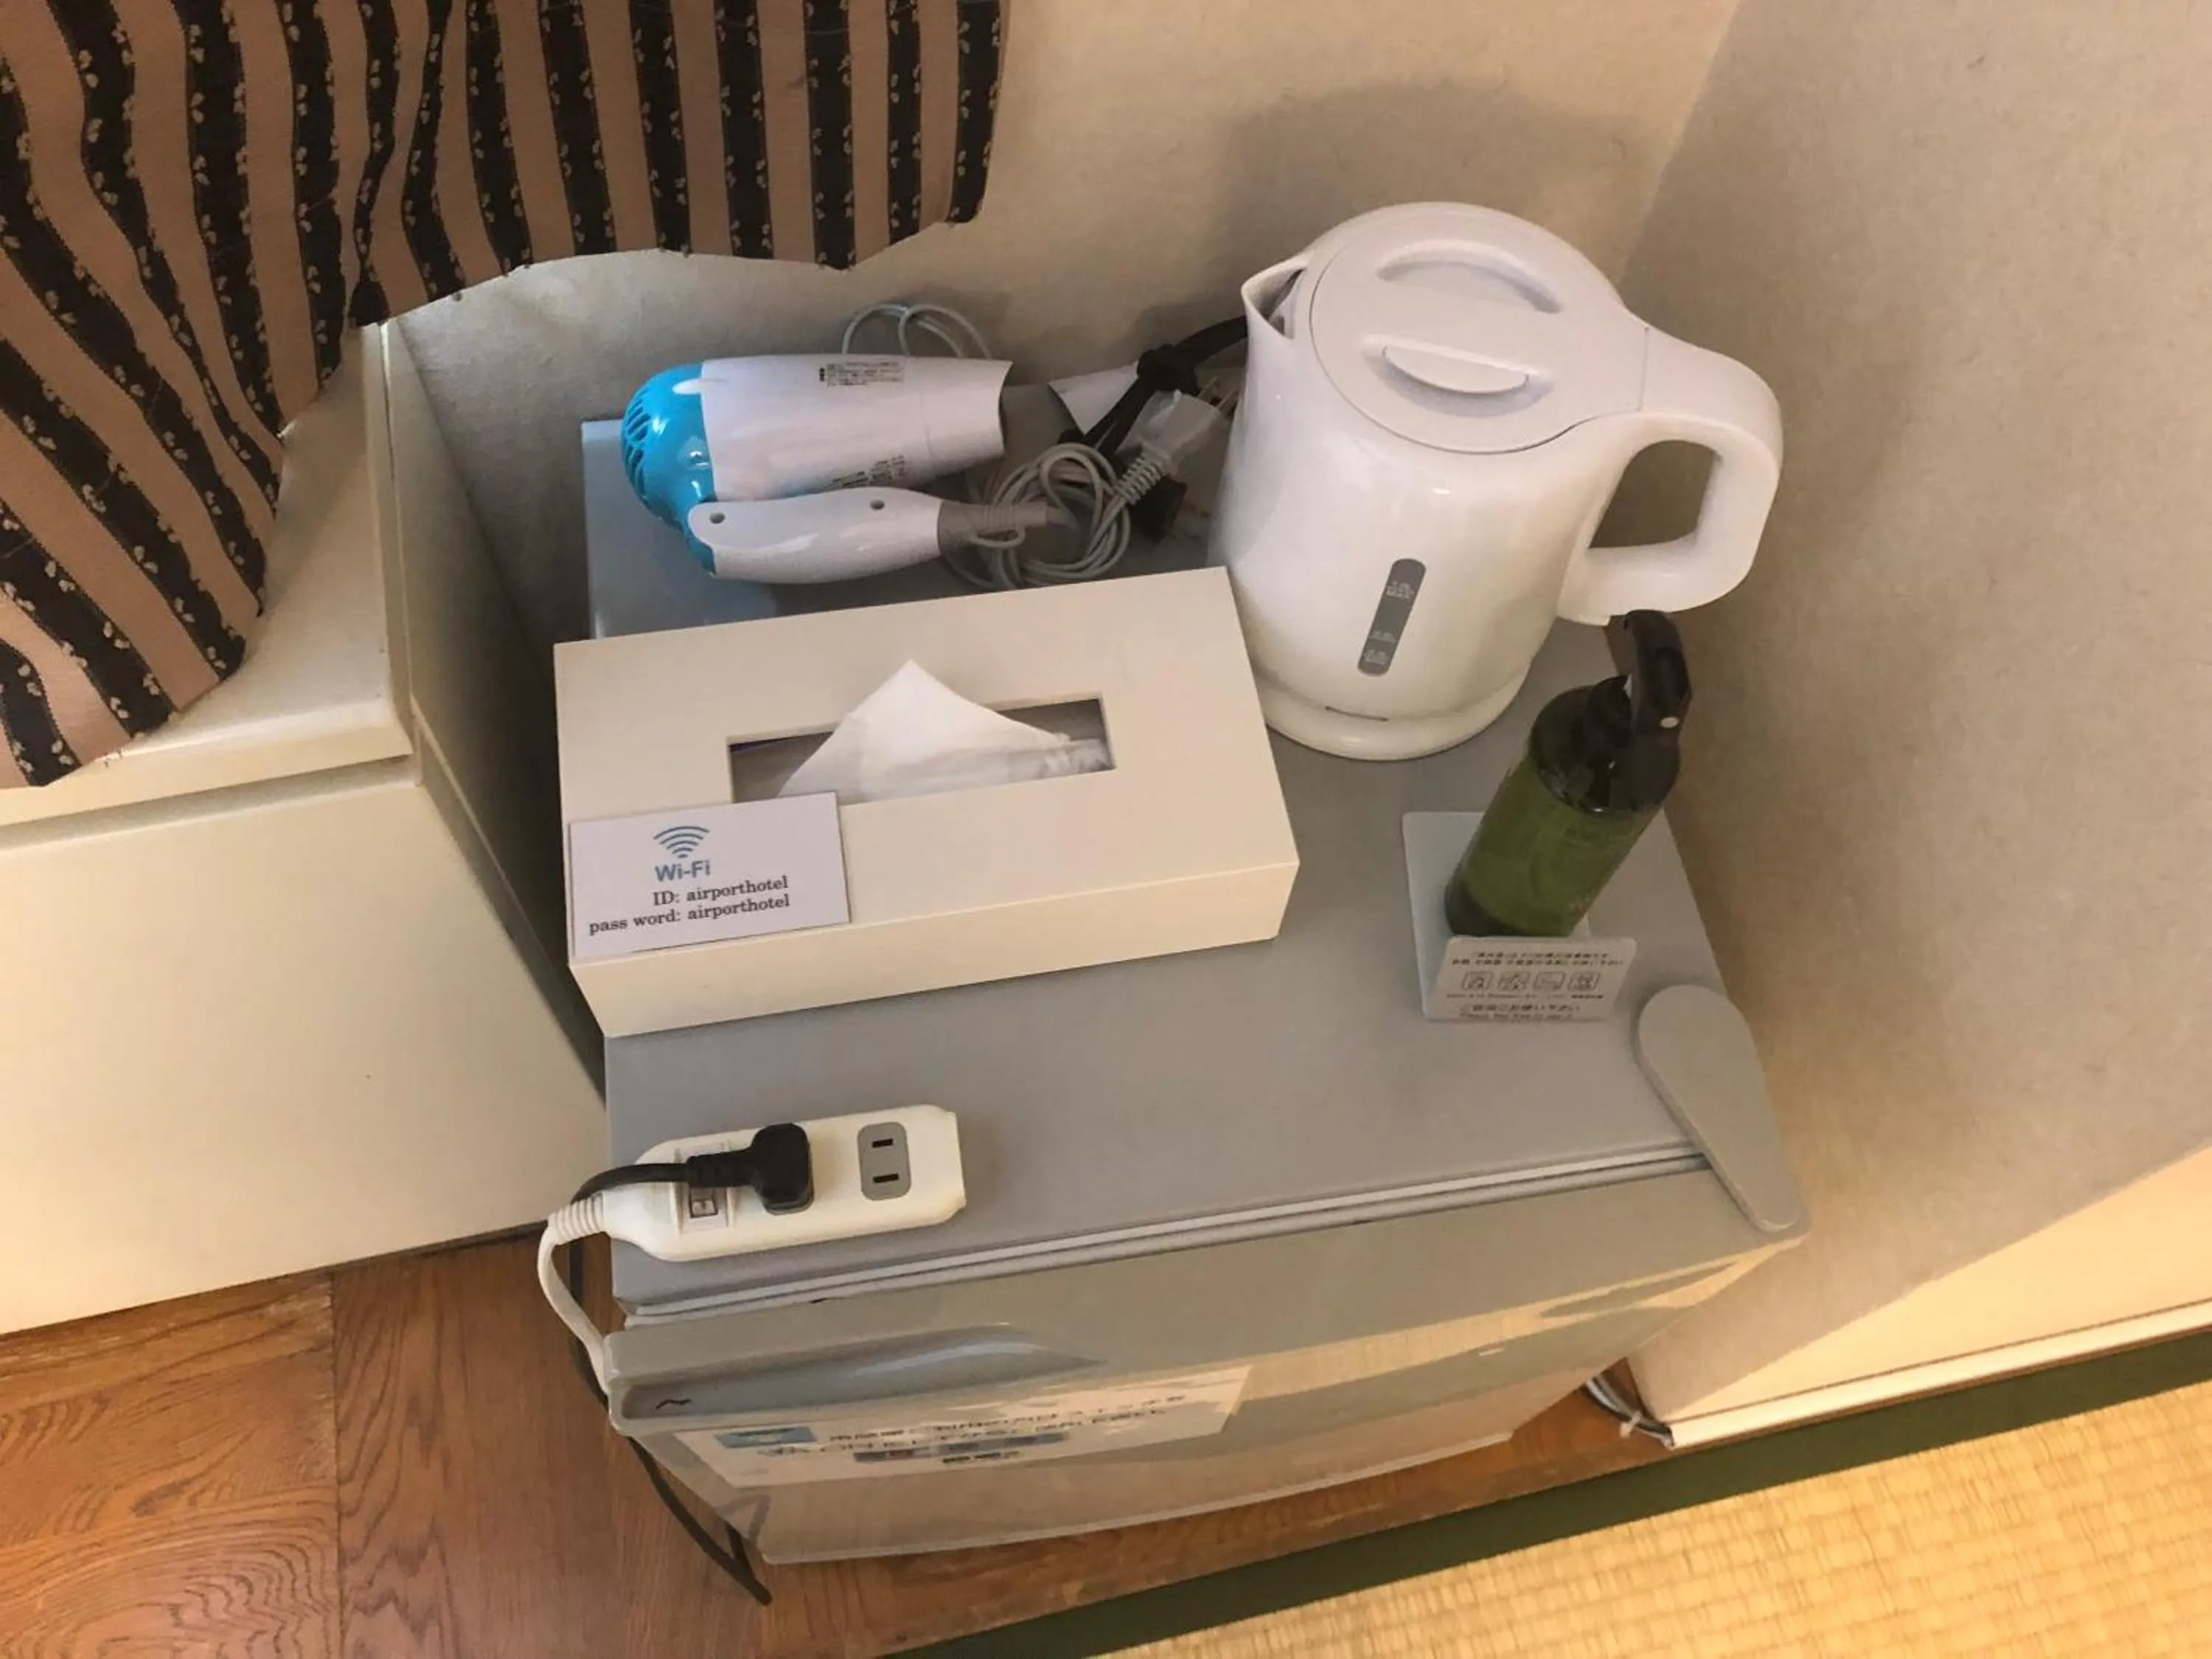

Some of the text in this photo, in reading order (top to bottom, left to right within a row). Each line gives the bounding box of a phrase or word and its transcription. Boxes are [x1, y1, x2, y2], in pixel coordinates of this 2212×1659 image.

[655, 859, 711, 882] Wi-Fi
[653, 875, 788, 905] ID: airporthotel
[589, 894, 790, 936] pass word: airporthotel
